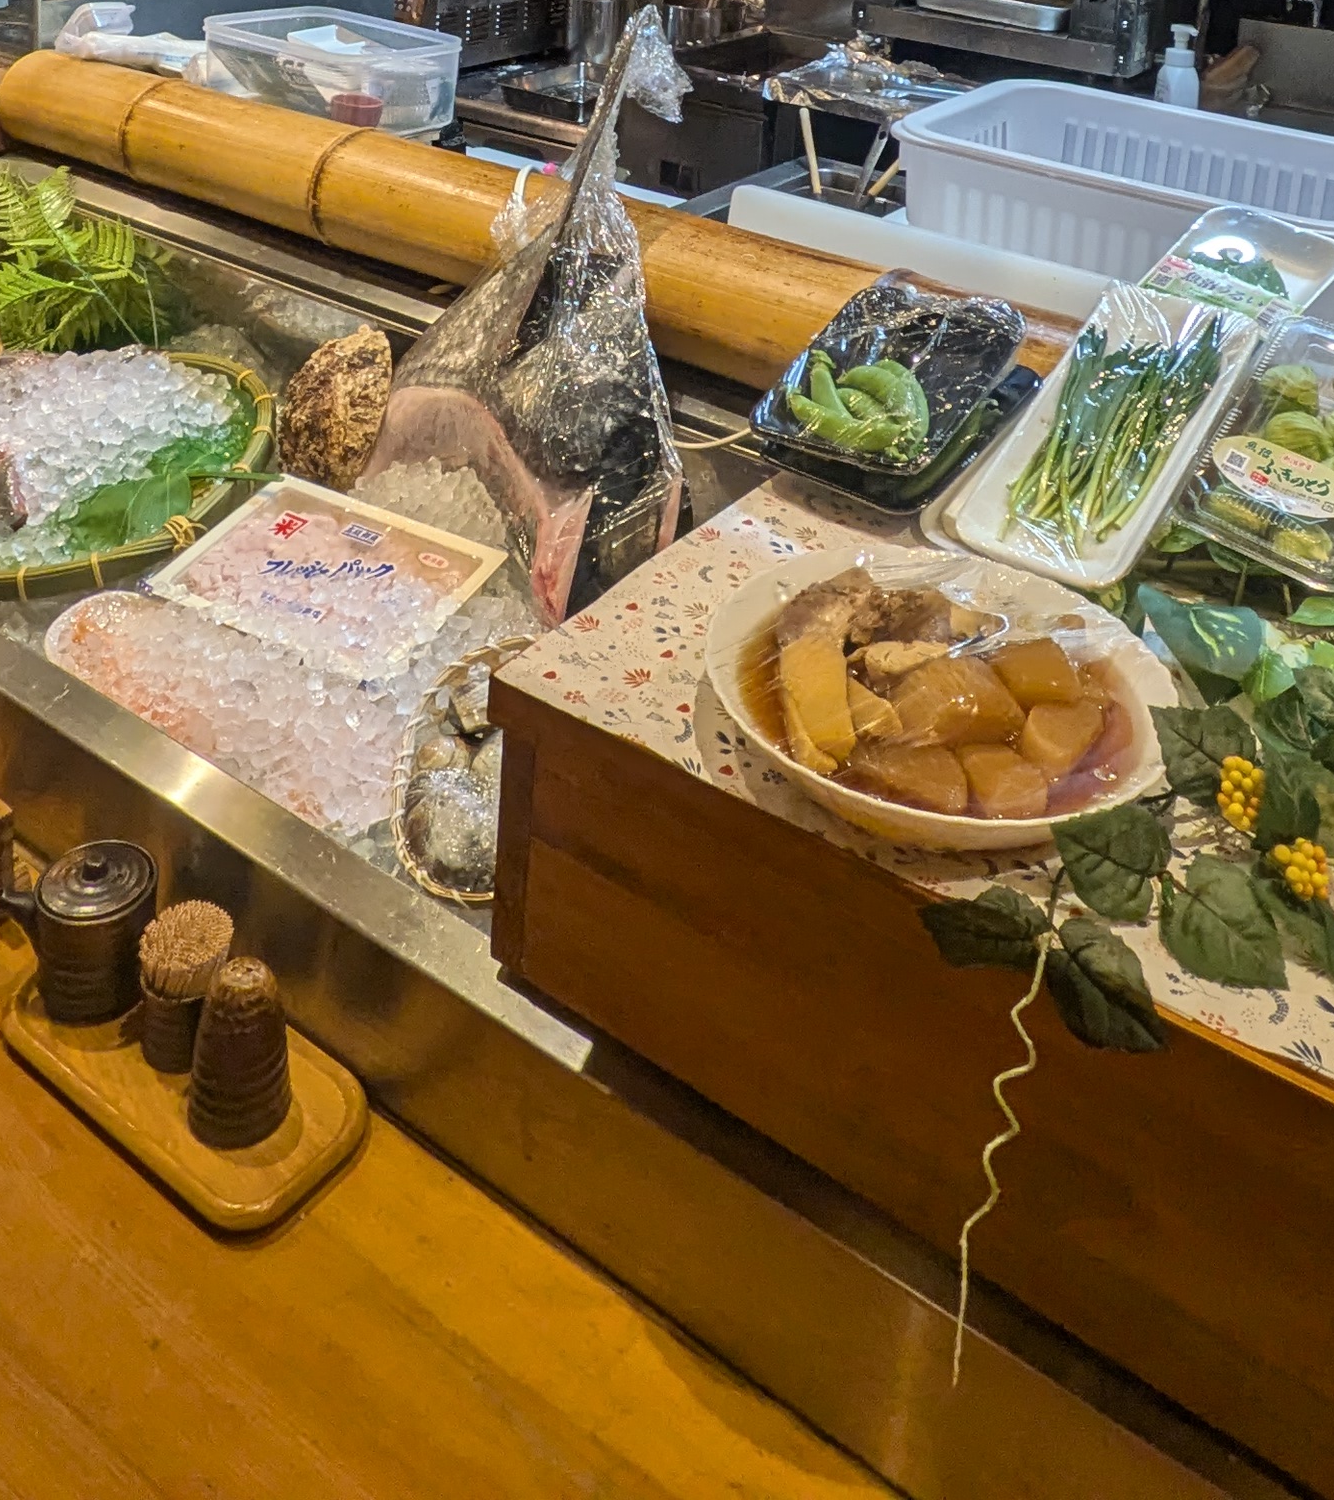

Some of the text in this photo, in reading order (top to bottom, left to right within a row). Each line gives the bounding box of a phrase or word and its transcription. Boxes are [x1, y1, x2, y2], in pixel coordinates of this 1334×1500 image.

[1257, 459, 1331, 496] ふきのとう
